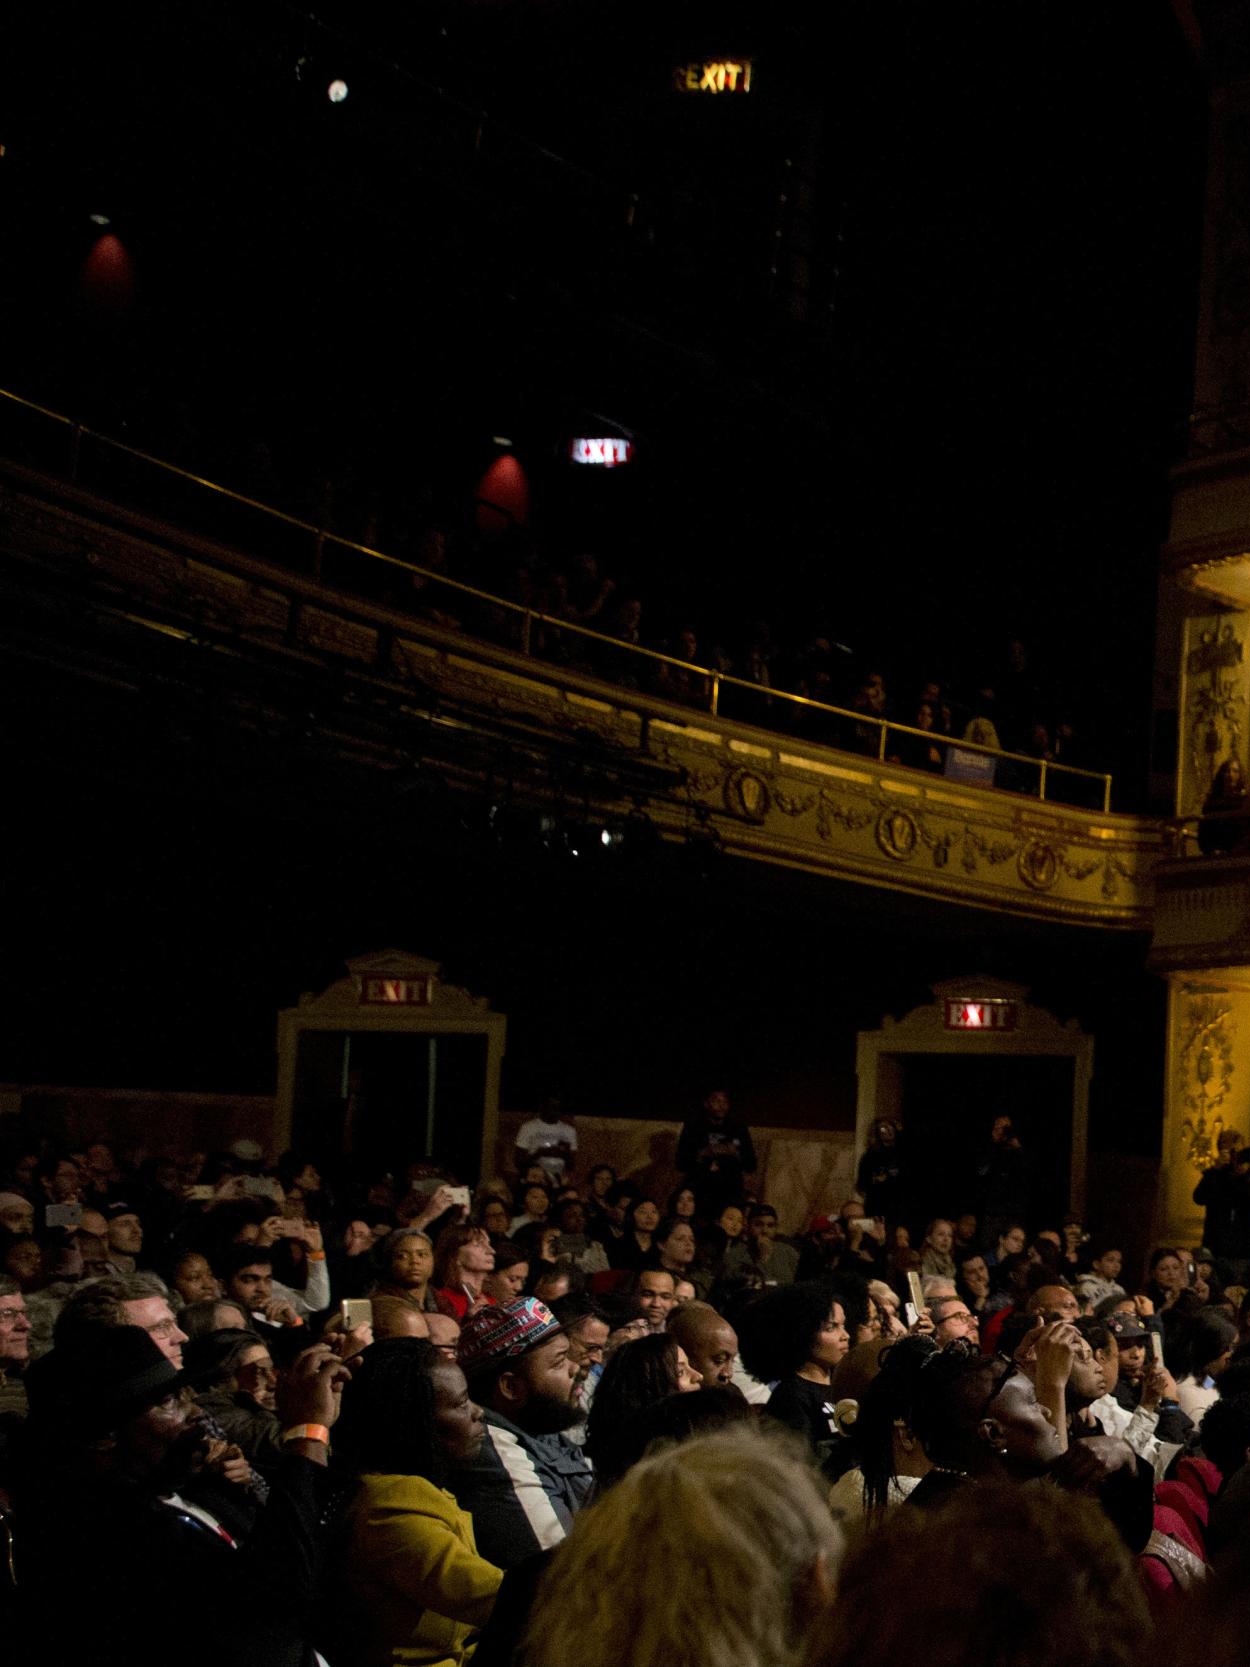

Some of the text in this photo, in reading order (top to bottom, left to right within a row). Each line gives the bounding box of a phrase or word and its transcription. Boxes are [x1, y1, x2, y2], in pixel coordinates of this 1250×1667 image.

[686, 61, 742, 94] EXIT
[572, 438, 629, 464] EXIT
[367, 980, 421, 1002] EXIT
[950, 1004, 1009, 1027] EXIT
